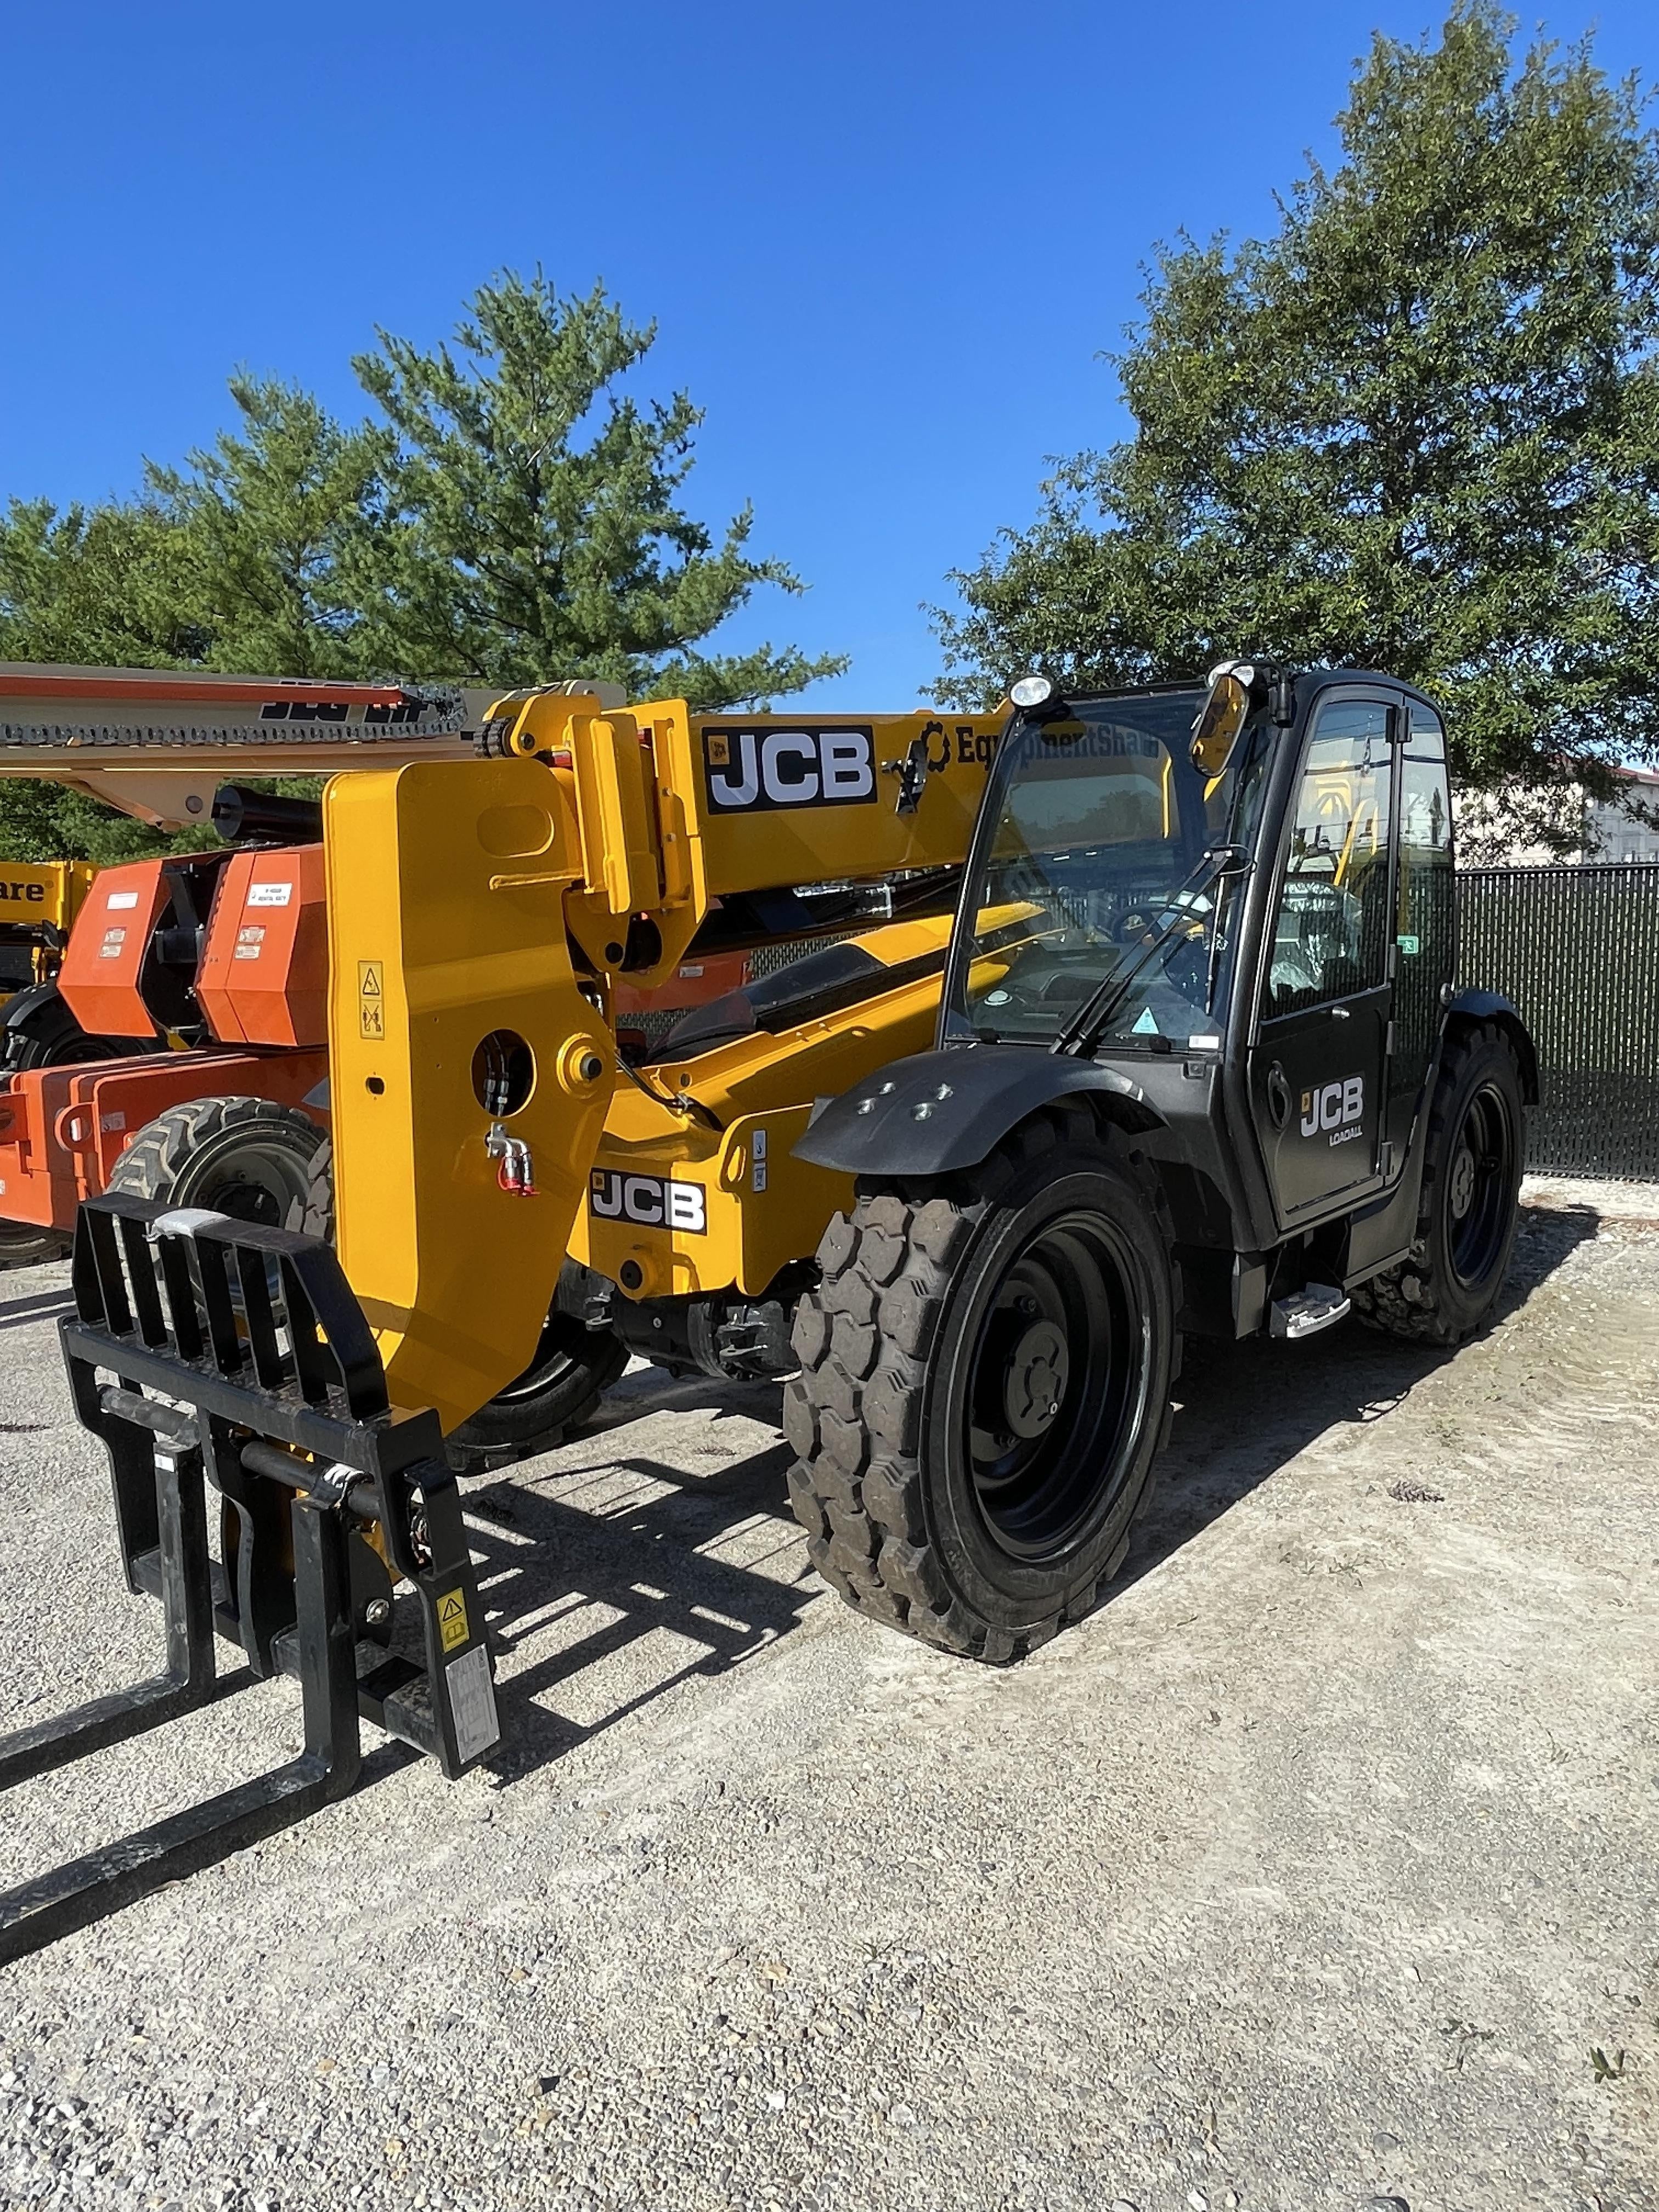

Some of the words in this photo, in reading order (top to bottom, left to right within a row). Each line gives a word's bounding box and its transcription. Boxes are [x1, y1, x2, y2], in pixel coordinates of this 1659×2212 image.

[711, 733, 873, 806] JCB
[1301, 1077, 1363, 1137] JCB
[593, 1174, 704, 1230] JCB
